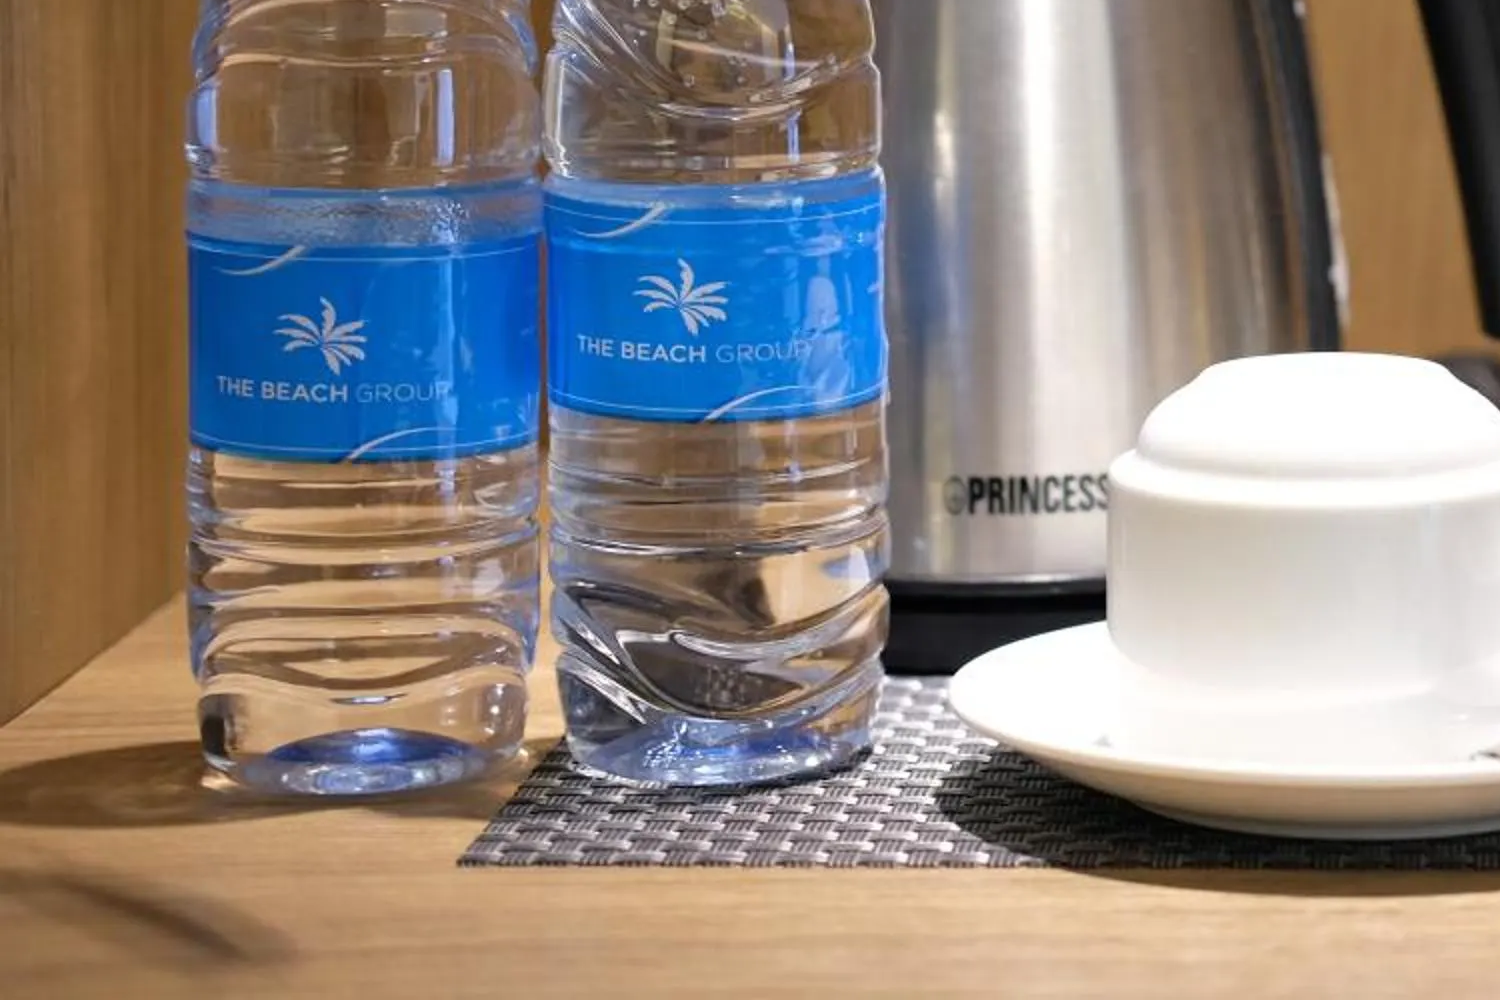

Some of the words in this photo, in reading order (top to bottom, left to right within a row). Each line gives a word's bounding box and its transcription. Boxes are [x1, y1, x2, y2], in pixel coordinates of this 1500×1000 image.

[576, 334, 614, 357] THE
[620, 341, 706, 364] BEACH
[715, 340, 812, 364] GROUP
[216, 374, 254, 398] THE
[260, 380, 349, 403] BEACH
[355, 380, 453, 403] GROUP
